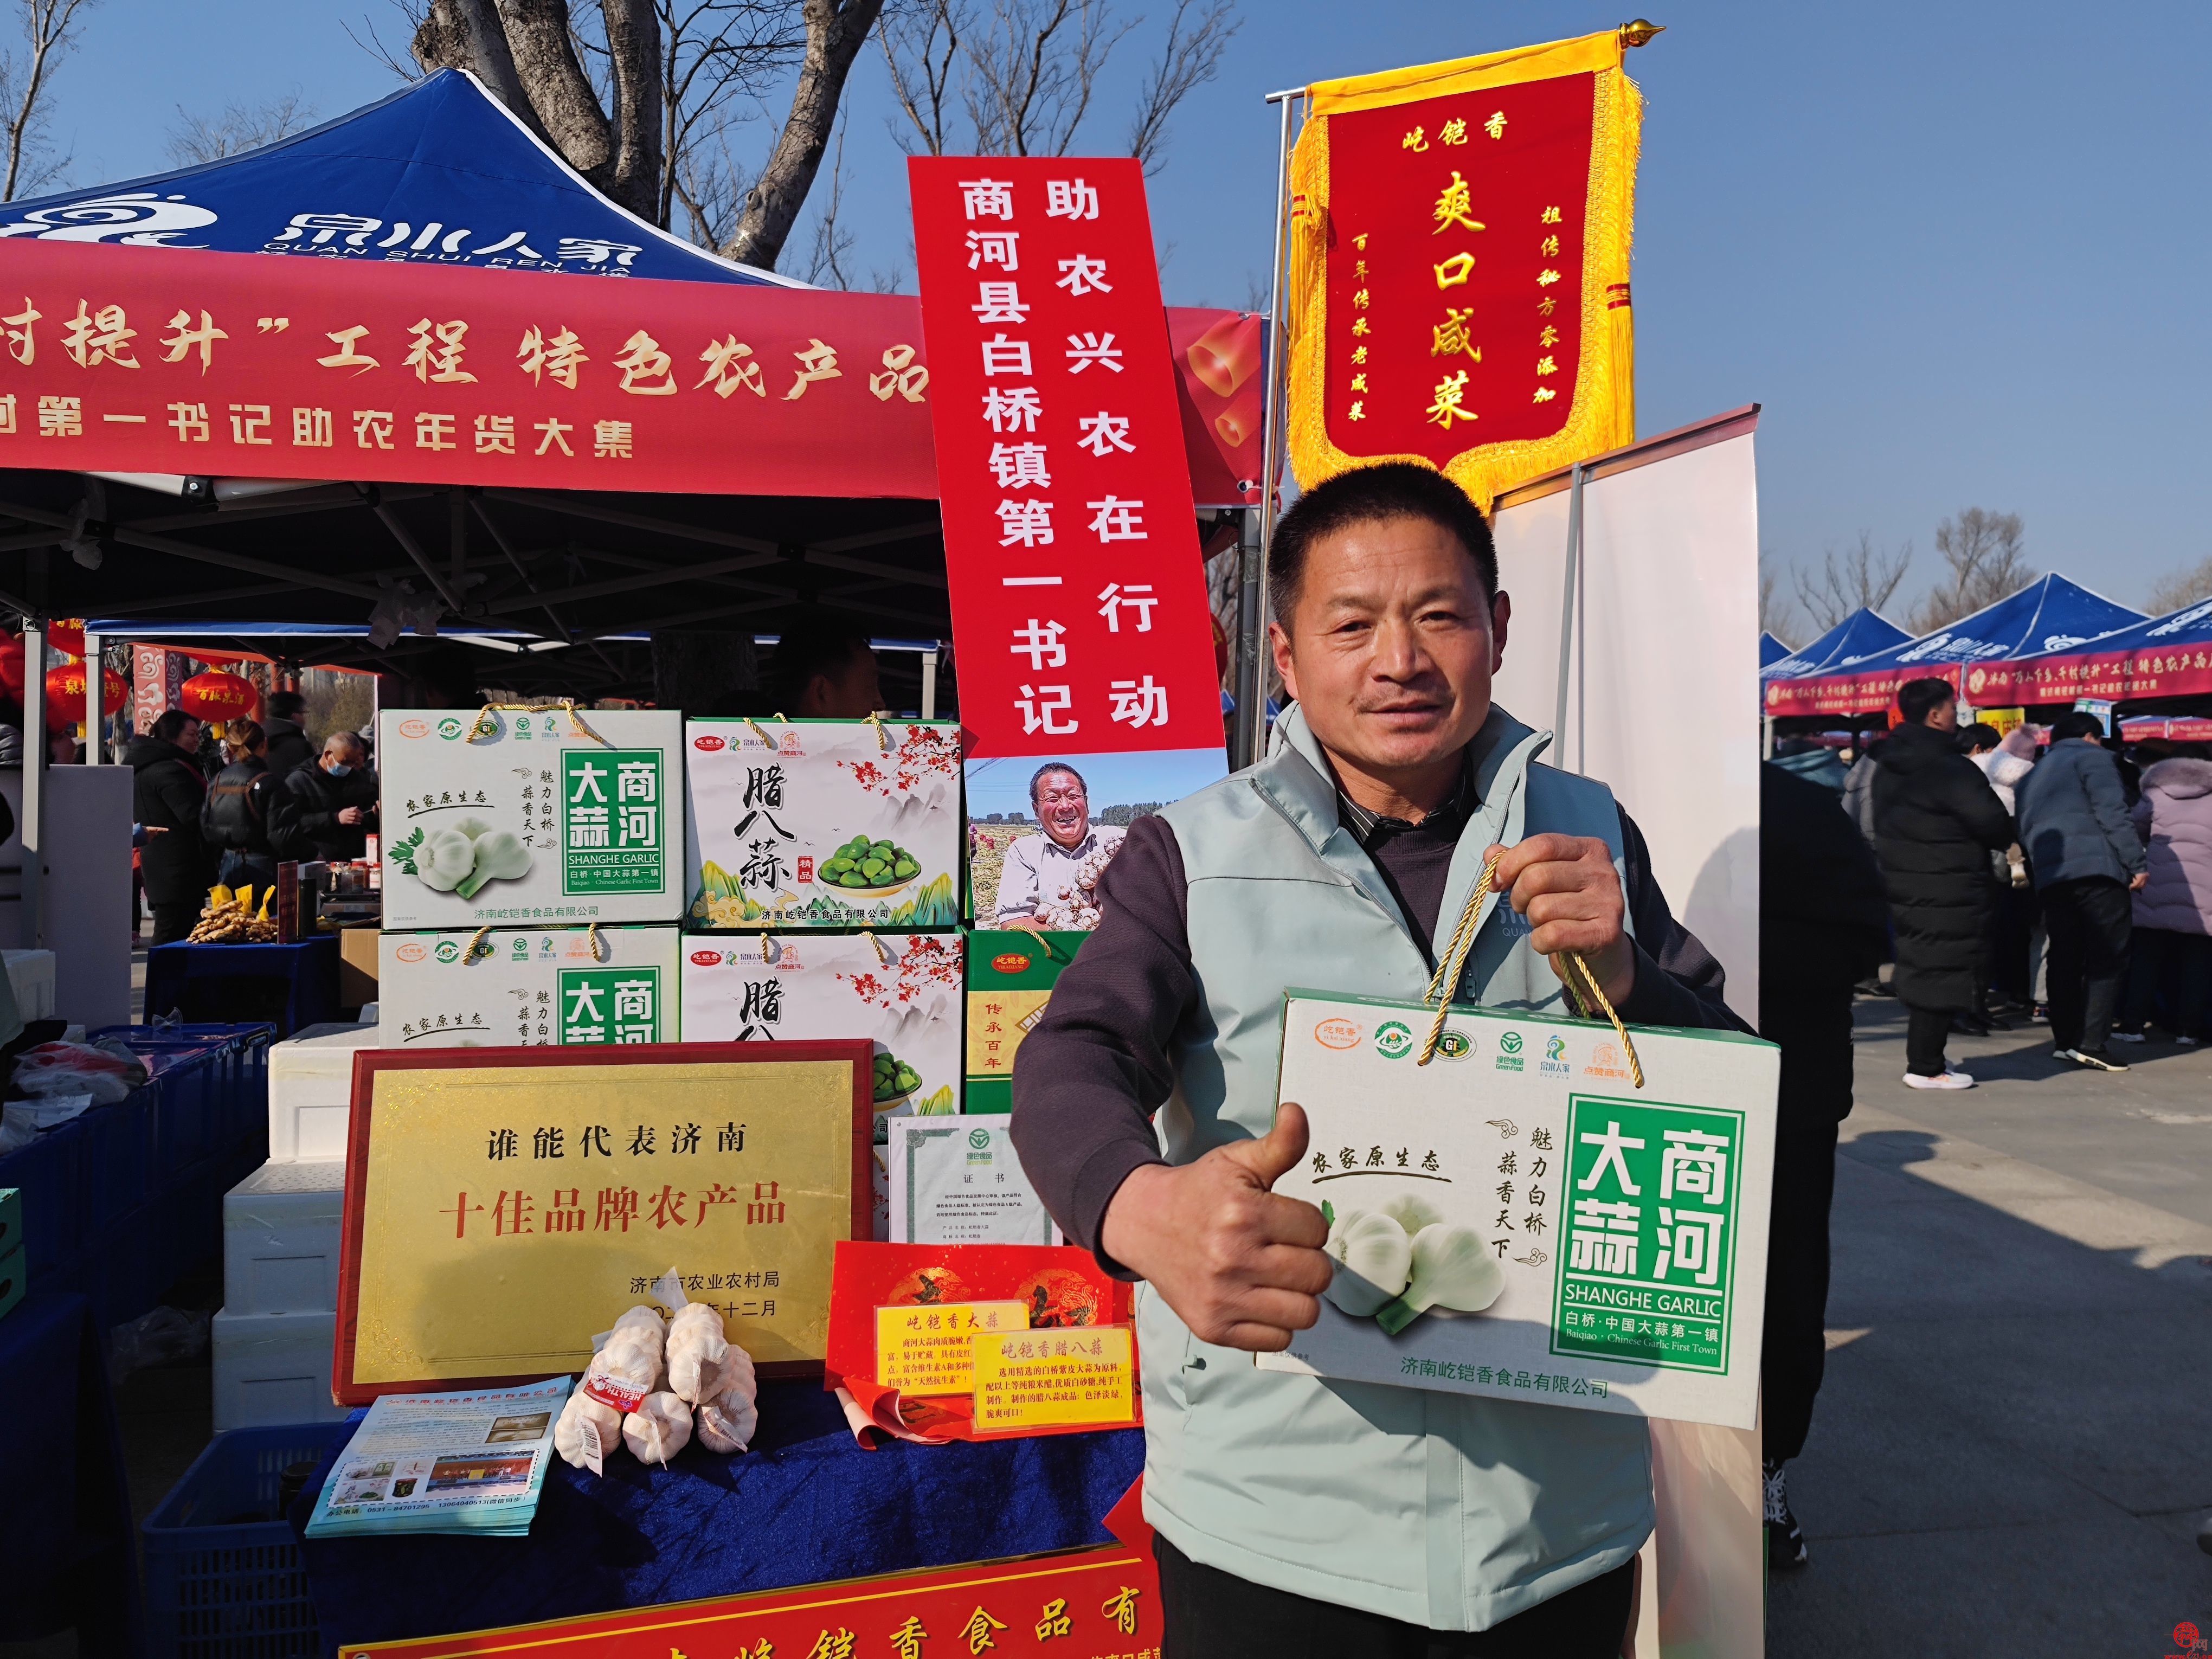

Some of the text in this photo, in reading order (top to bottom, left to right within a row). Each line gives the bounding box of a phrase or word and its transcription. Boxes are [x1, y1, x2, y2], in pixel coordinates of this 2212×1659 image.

[264, 243, 369, 255] QUAN
[387, 250, 471, 262] SHUI
[491, 257, 562, 268] REN
[581, 265, 631, 273] JIA
[273, 214, 644, 266] 泉水人家
[959, 178, 1079, 736] 商河县白桥镇第一书记
[1046, 179, 1168, 729] 助农兴农在行动
[522, 786, 536, 847] 蒜香天下
[540, 770, 555, 831] 魅力白桥
[569, 762, 609, 847] 大蒜
[618, 761, 656, 847] 商河
[734, 761, 795, 890] 腊八蒜
[569, 854, 659, 865] SHANGHE GARLIC
[474, 906, 598, 920] 济南屹铠香食品有限公司
[762, 909, 889, 920] 济南屹铠香食品有限公司
[985, 1004, 1002, 1069] 传承百年
[1323, 1025, 1356, 1036] 屹铠香
[1496, 1056, 1524, 1065] 绿色食品
[485, 1121, 748, 1161] 谁能代表济南
[1312, 1145, 1441, 1174] 农家原生态
[1491, 1153, 1517, 1259] 蒜香天下
[1523, 1127, 1553, 1236] 魅力白桥
[1570, 1121, 1645, 1276] 大蒜
[1652, 1129, 1730, 1286] 商河
[439, 1181, 786, 1239] 十佳品牌农产品
[907, 1310, 999, 1330] 屹铠香大蒜
[1565, 1283, 1721, 1317] SHANGHE GARLIC
[1002, 1338, 1103, 1359] 屹铠香腊八蒜
[1566, 1328, 1718, 1355] Baiqiao Chinese Garlic First Town
[1400, 1355, 1609, 1399] 济南屹铠香食品有限公司
